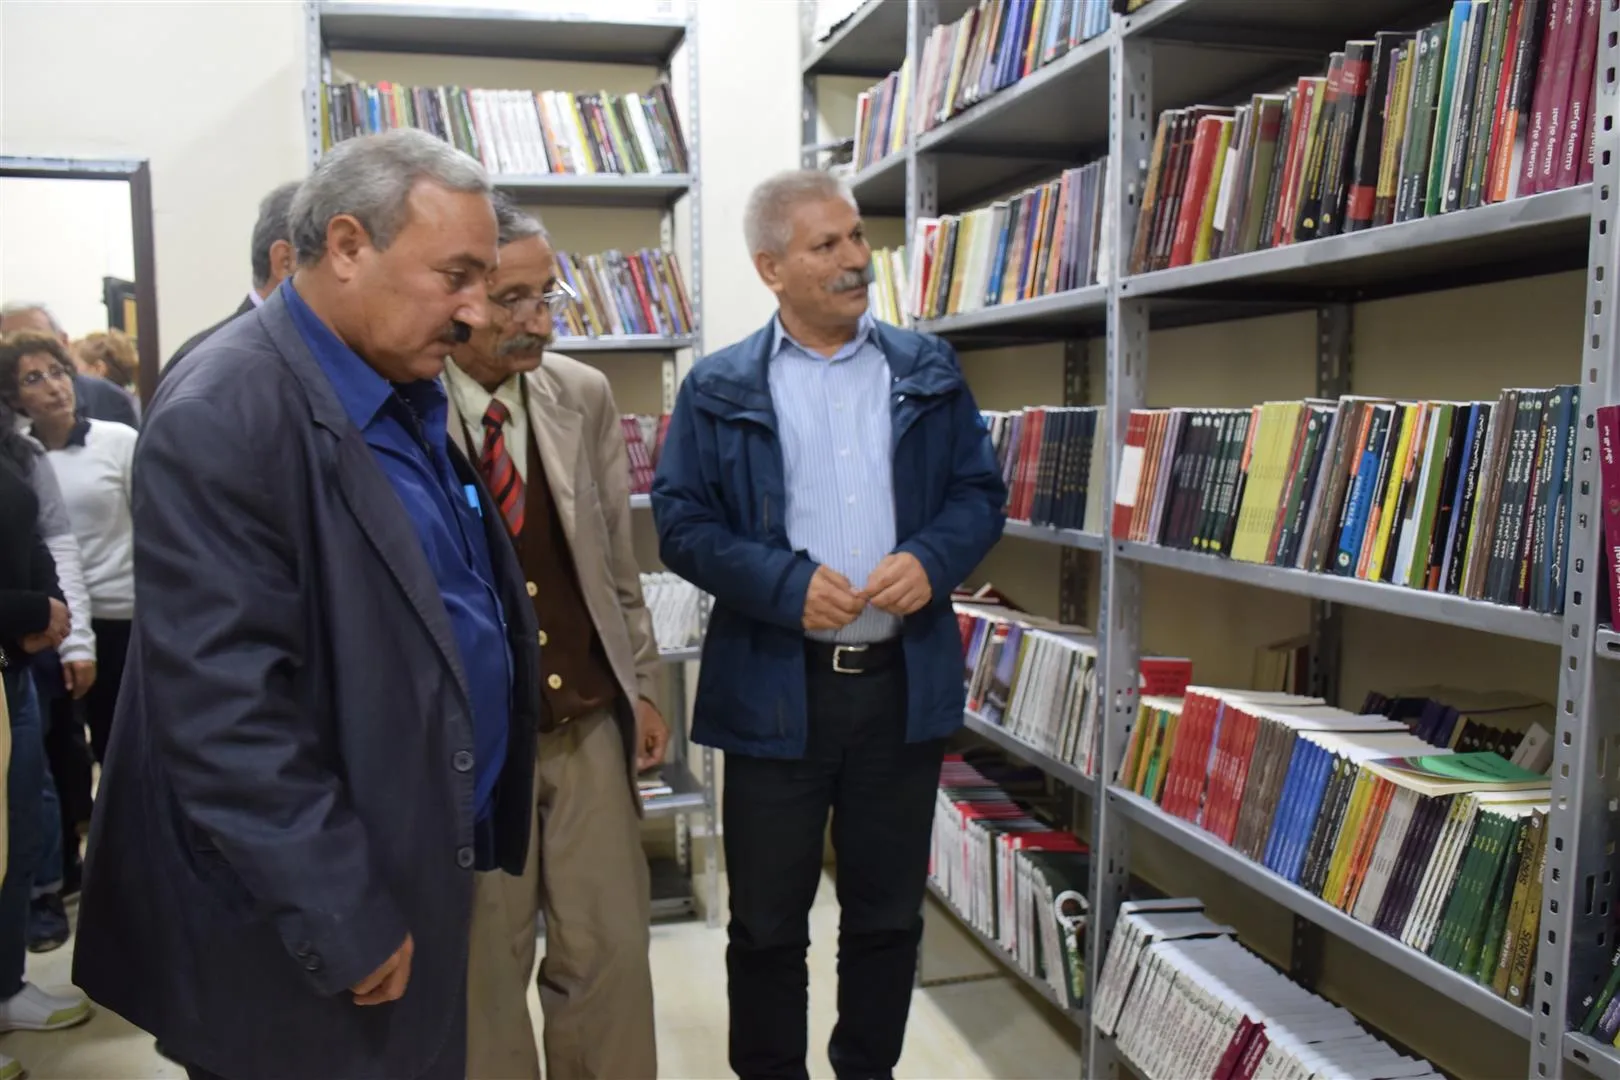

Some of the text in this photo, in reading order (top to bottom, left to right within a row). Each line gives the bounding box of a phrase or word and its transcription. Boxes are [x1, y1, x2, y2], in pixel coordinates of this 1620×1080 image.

[1524, 110, 1544, 178] المرأة والعائلة
[1541, 105, 1561, 176] المرأة والعائلة
[1562, 100, 1583, 171] المرأة والعائلة
